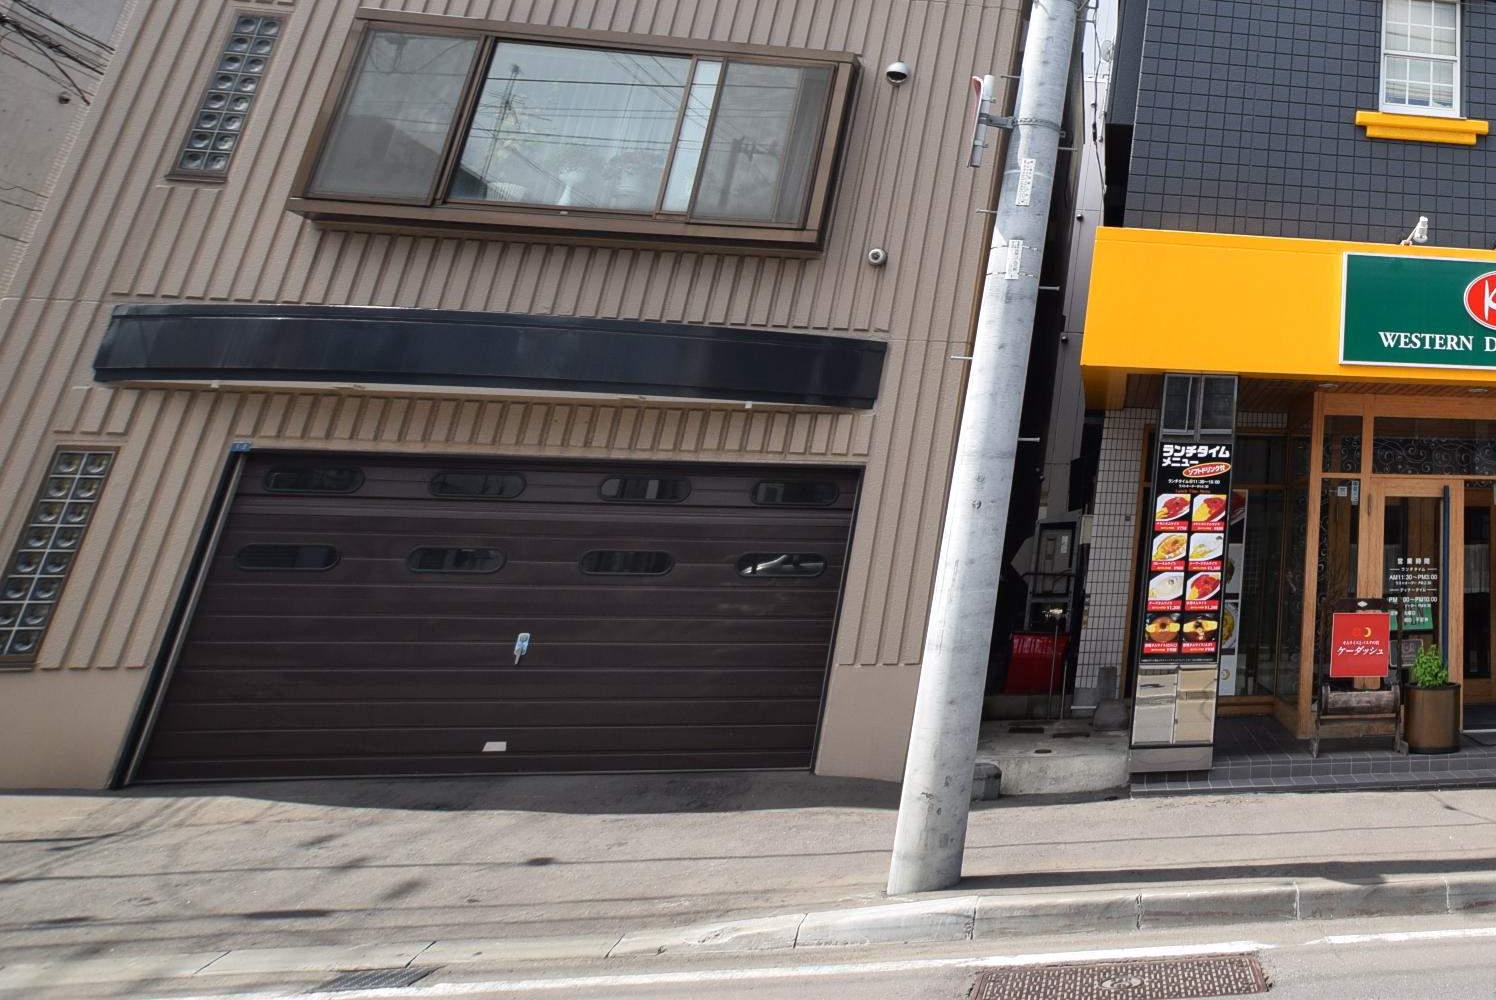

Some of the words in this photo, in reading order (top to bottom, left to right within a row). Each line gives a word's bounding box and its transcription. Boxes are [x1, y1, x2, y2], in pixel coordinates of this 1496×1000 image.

[1378, 331, 1474, 351] WESTERN
[1162, 444, 1230, 458] ランチタイム
[1161, 457, 1199, 467] メニュー
[1337, 646, 1384, 657] ケーダッシュ
